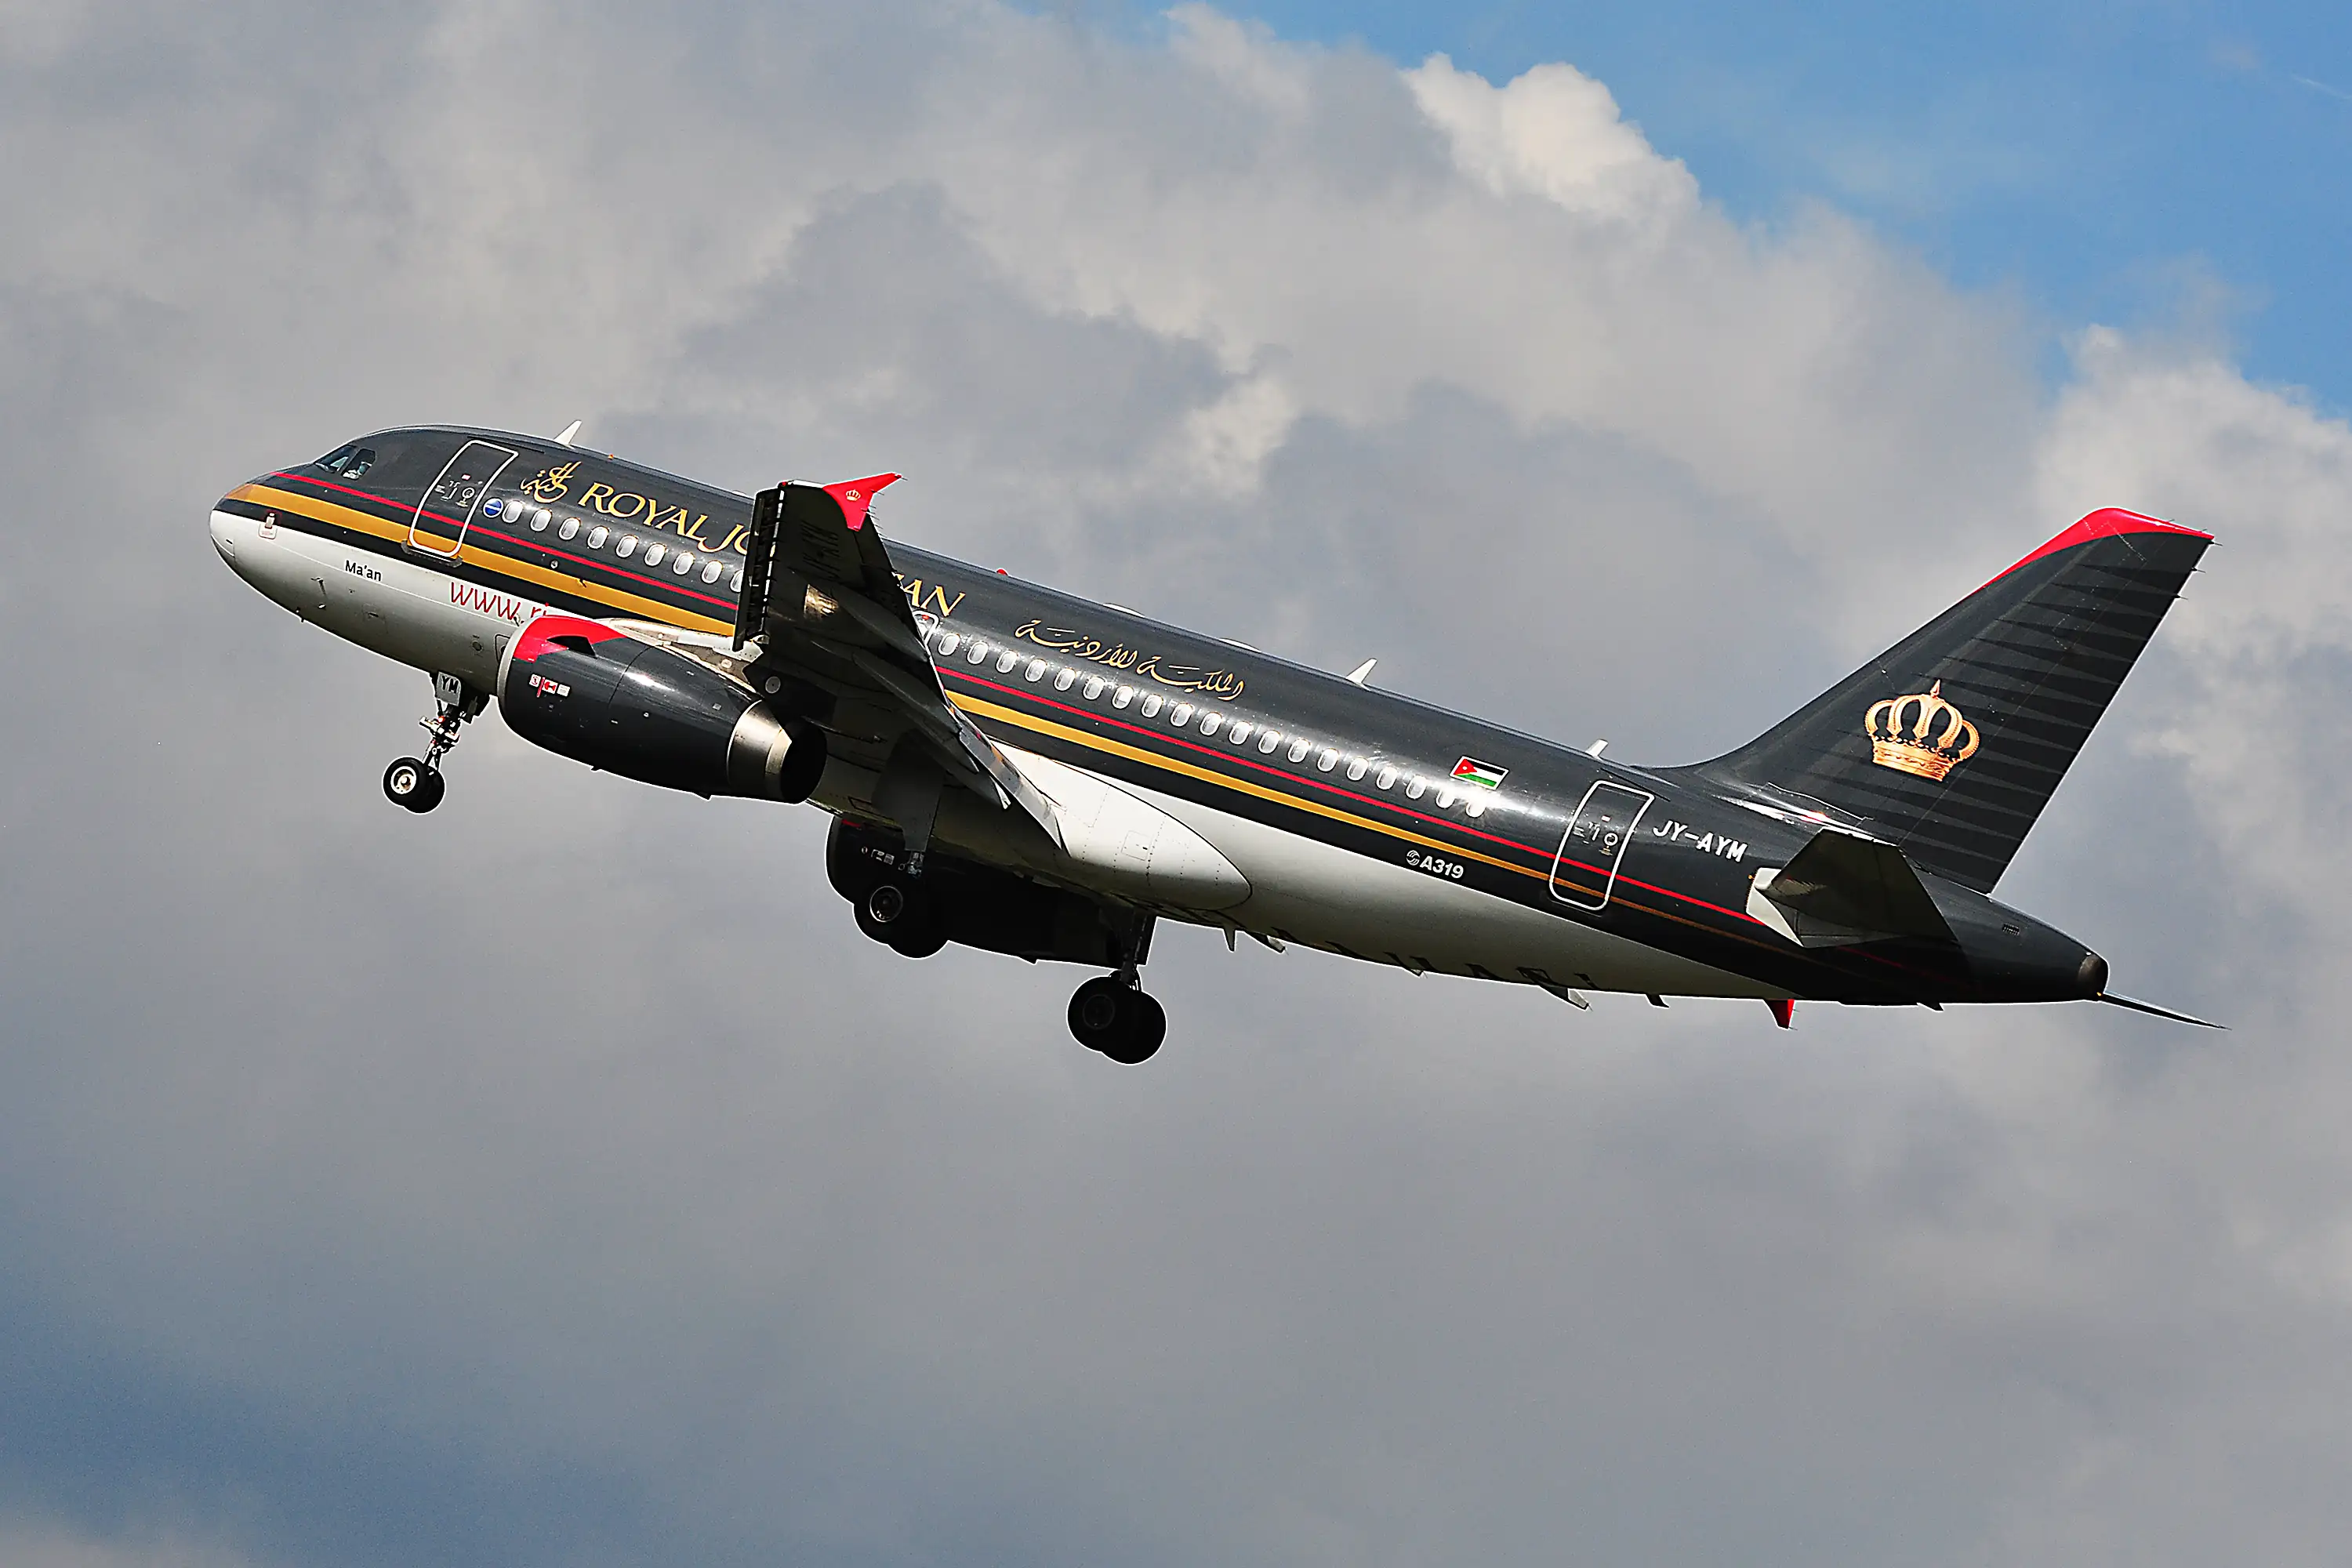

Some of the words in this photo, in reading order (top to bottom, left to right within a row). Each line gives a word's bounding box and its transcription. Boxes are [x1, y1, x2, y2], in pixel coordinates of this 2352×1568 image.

[578, 481, 708, 543] ROYAL
[344, 559, 382, 583] Ma'an
[441, 675, 459, 695] YM
[1652, 819, 1749, 862] JY-AYM
[1419, 855, 1465, 880] A319
